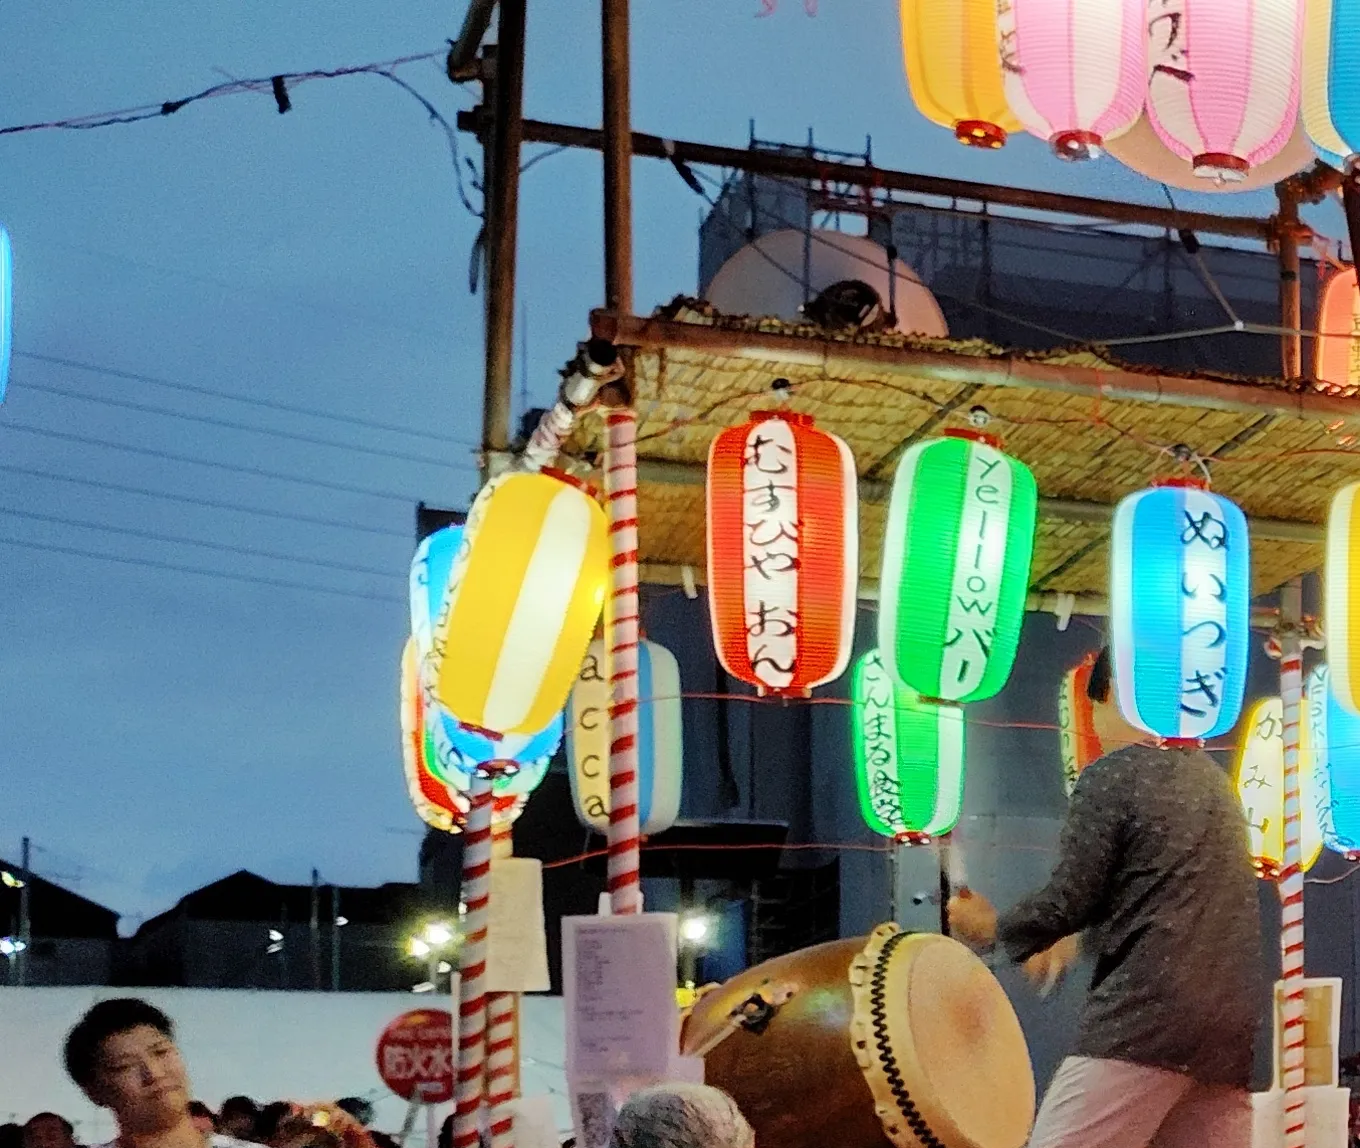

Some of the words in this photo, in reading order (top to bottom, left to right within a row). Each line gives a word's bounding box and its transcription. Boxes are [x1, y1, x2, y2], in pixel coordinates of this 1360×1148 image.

[744, 435, 801, 579] むすびや
[748, 603, 798, 675] おん
[1180, 511, 1227, 717] ぬいつぎ
